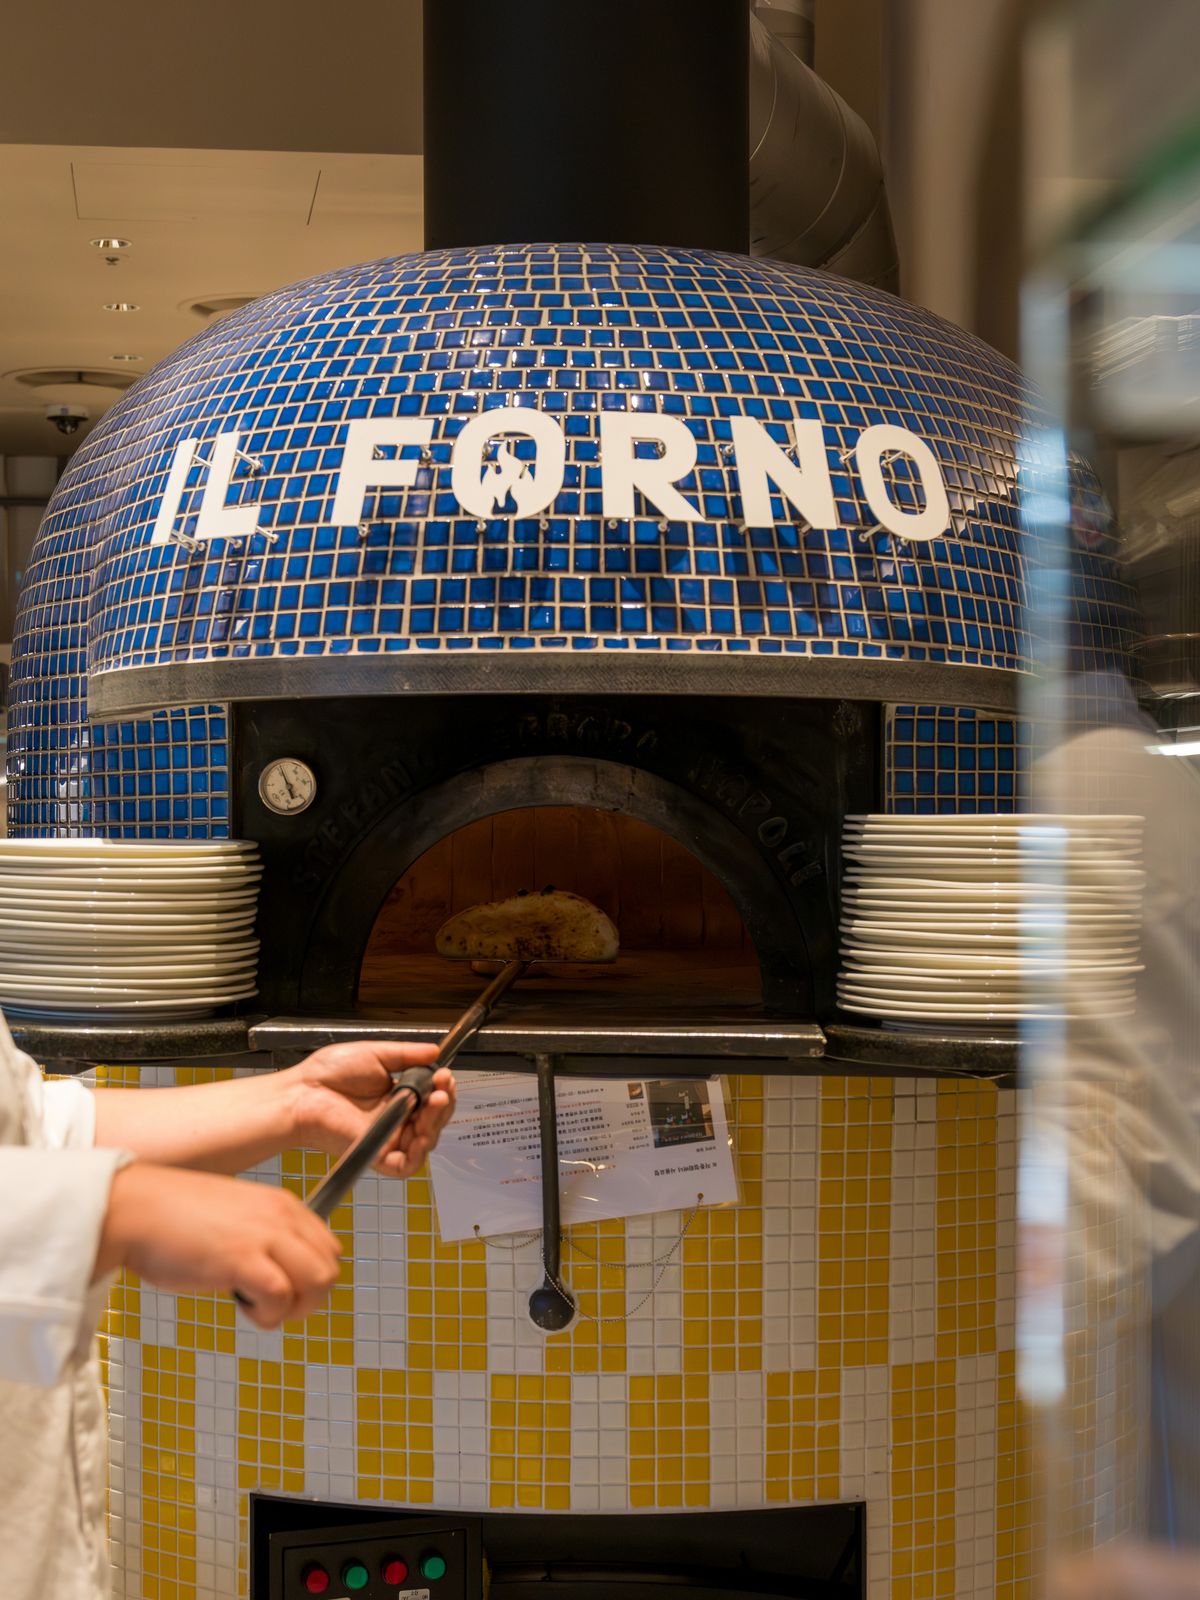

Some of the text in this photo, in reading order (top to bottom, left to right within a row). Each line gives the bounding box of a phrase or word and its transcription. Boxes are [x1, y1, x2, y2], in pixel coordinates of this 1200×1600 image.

[151, 407, 950, 545] IL FORNO
[287, 752, 440, 889] STEFAN
